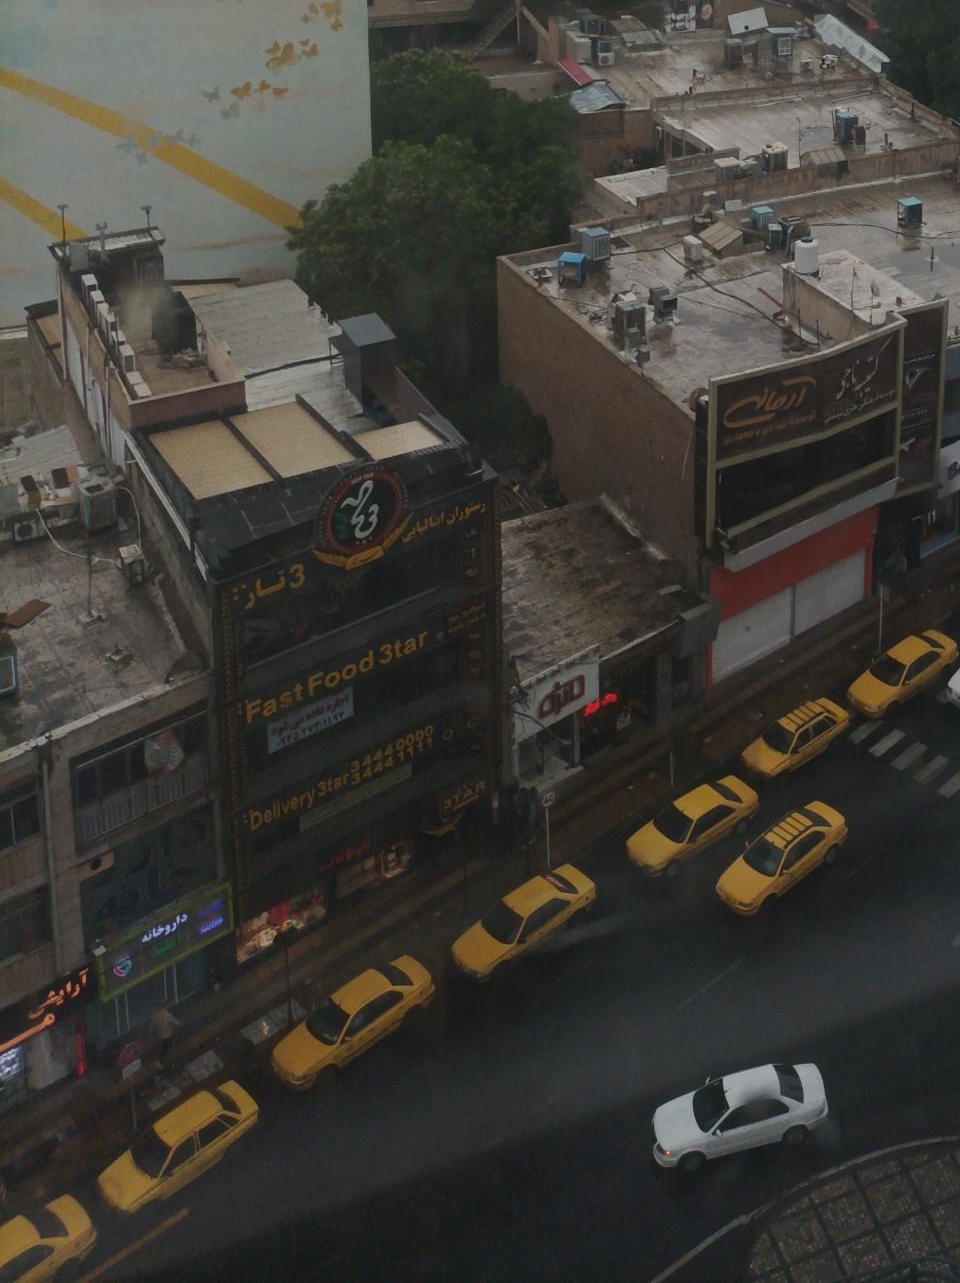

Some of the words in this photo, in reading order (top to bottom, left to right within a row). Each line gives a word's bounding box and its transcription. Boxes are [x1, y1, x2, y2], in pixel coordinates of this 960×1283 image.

[245, 681, 304, 726] Fast
[307, 648, 375, 697] Food
[378, 629, 430, 667] 3tar
[247, 789, 316, 831] Delivery
[318, 772, 348, 798] 3tar
[141, 912, 189, 944] داروخانه
